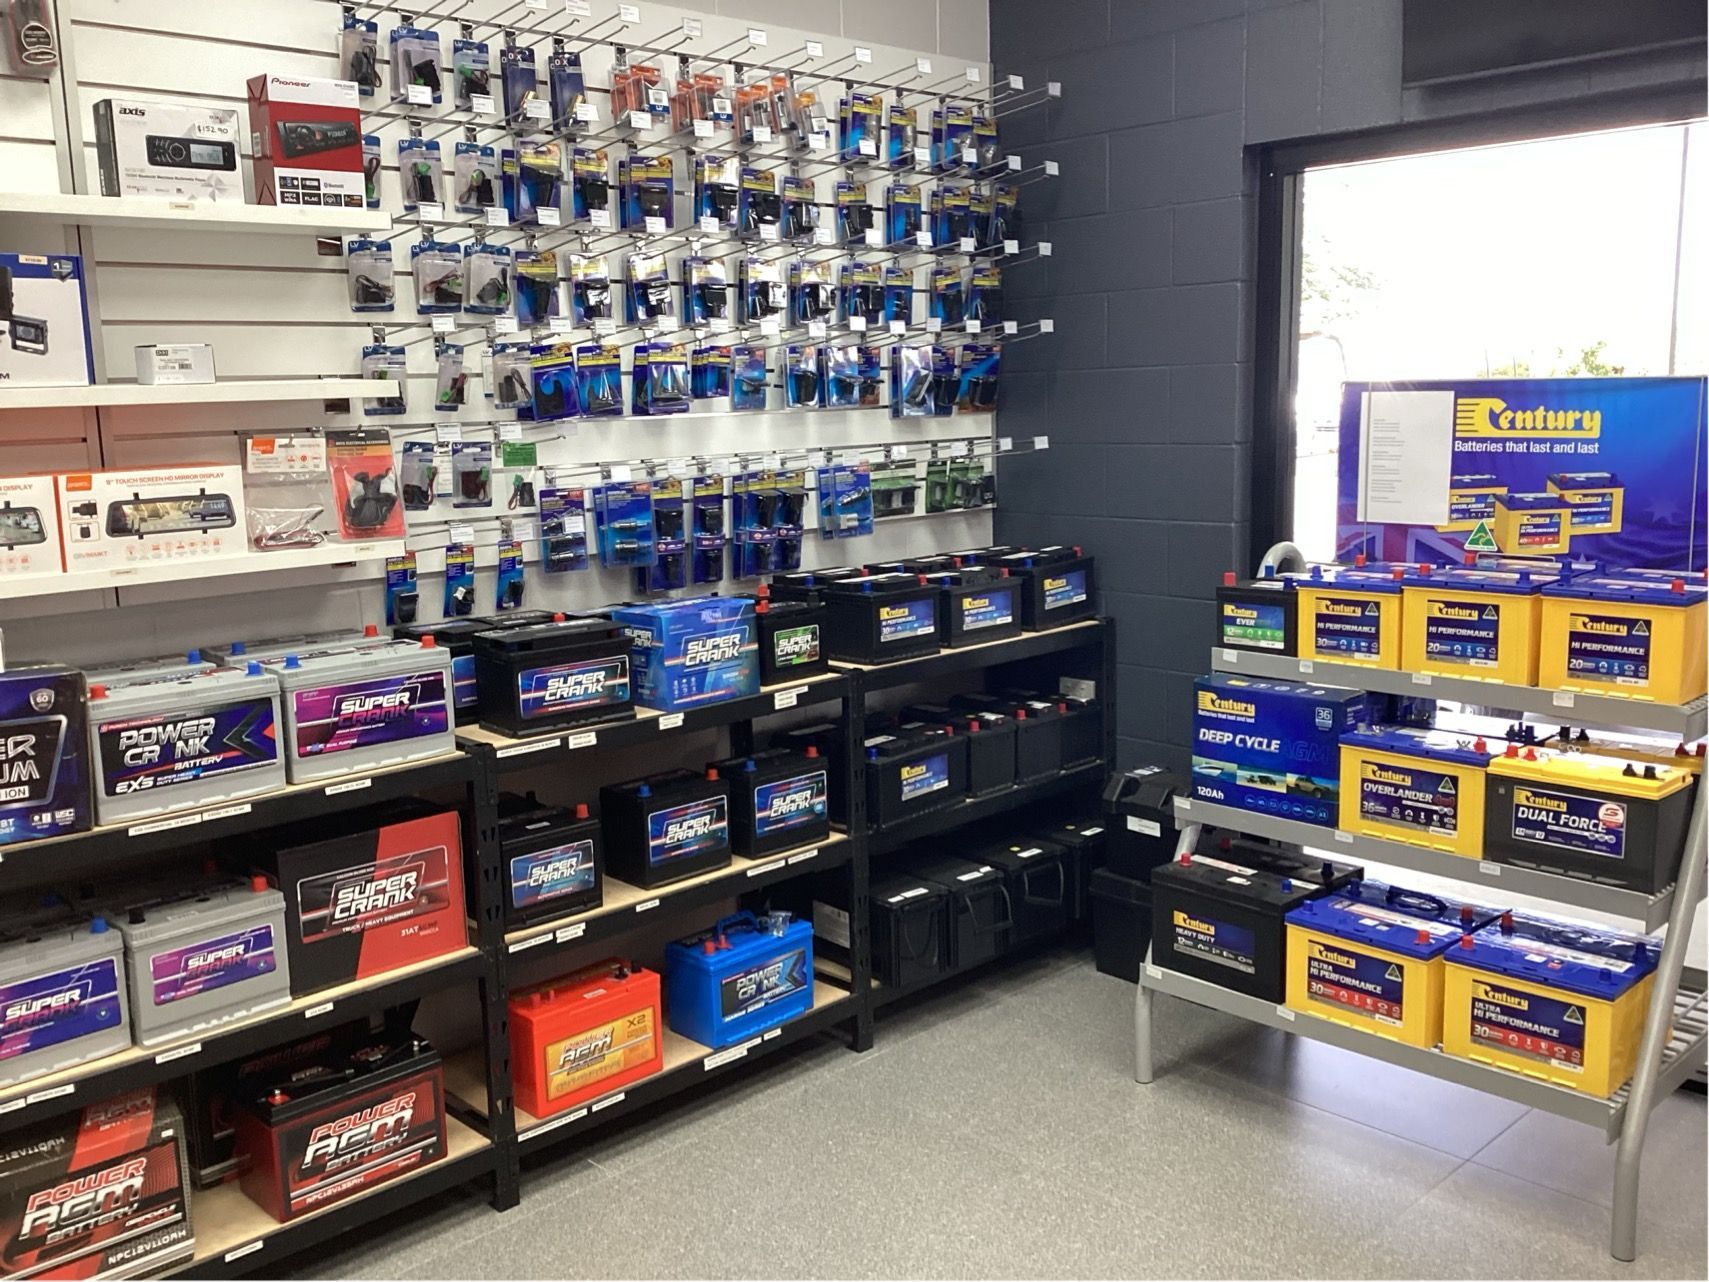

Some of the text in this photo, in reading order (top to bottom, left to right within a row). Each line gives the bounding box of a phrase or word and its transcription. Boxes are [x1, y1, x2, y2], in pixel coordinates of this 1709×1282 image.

[271, 78, 311, 88] Pioneer
[119, 107, 146, 117] axis
[1455, 398, 1602, 438] Century
[1454, 441, 1600, 454] Batteries that last and last
[199, 472, 225, 480] DISPLAY
[1224, 604, 1258, 618] Century
[1315, 600, 1362, 617] Century
[1427, 602, 1478, 620] Century
[1236, 618, 1255, 626] EVER
[1326, 622, 1376, 634] PERFORMANCE
[1570, 616, 1628, 636] Century
[624, 629, 652, 640] SUPER
[778, 634, 812, 648] SUPER
[1429, 626, 1494, 638] HI PERFORMANCE
[688, 634, 741, 653] SUPER
[777, 643, 811, 656] CRANK
[1316, 638, 1327, 647] 30
[1428, 643, 1440, 652] 20
[1572, 642, 1645, 656] HI PERFORMANCE
[686, 646, 740, 666] CRANK
[1570, 659, 1583, 668] 20
[547, 670, 606, 688] SUPER
[544, 682, 604, 701] CRANK
[340, 691, 410, 714] SUPER
[1198, 690, 1256, 717] Century
[338, 704, 409, 727] CRANK
[1317, 710, 1331, 720] 36
[119, 717, 216, 750] POWER
[1200, 728, 1234, 744] DEEP
[1235, 734, 1280, 753] CYCLE
[174, 754, 224, 770] BATTERY
[1361, 762, 1412, 786] Century
[116, 776, 155, 794] EXS
[1197, 786, 1224, 800] 120Ah
[1364, 782, 1434, 803] OVERLANDER
[772, 790, 812, 807] SUPER
[1362, 801, 1374, 812] 36
[1514, 789, 1568, 812] Century
[770, 800, 810, 818] CRANK
[667, 814, 711, 835] SUPER
[1518, 806, 1556, 824] DUAL
[1559, 814, 1607, 834] FORCE
[666, 826, 710, 845] CRANK
[531, 857, 577, 876] SUPER
[530, 868, 576, 887] CRANK
[337, 871, 418, 905] SUPER
[334, 884, 416, 920] CRANK
[342, 924, 361, 932] TRUCK
[365, 918, 384, 926] HEAVY
[384, 910, 414, 922] EQUIPMENT
[1174, 910, 1215, 936] Century
[1176, 927, 1216, 944] HEAVY DUTY
[1177, 936, 1185, 944] 12
[187, 944, 245, 970] SUPER
[1308, 944, 1356, 968] Century
[1310, 960, 1333, 972] ULTRA
[736, 962, 784, 991] POWER
[1310, 968, 1382, 994] HI PERFORMANCE
[1310, 982, 1324, 994] 30
[1472, 984, 1528, 1010] Century
[6, 988, 81, 1021] SUPER
[1474, 1000, 1501, 1014] ULTRA
[627, 1014, 646, 1028] X2
[1473, 1024, 1490, 1037] 30
[1474, 1008, 1560, 1038] HI PERFORMANCE
[559, 1034, 614, 1069] AGM
[310, 1092, 416, 1144] POWER
[302, 1108, 414, 1170] AGM
[325, 1132, 408, 1172] BATTERY
[26, 1157, 148, 1214] POWER
[18, 1175, 145, 1240] AGM
[46, 1202, 139, 1245] BATTERY
